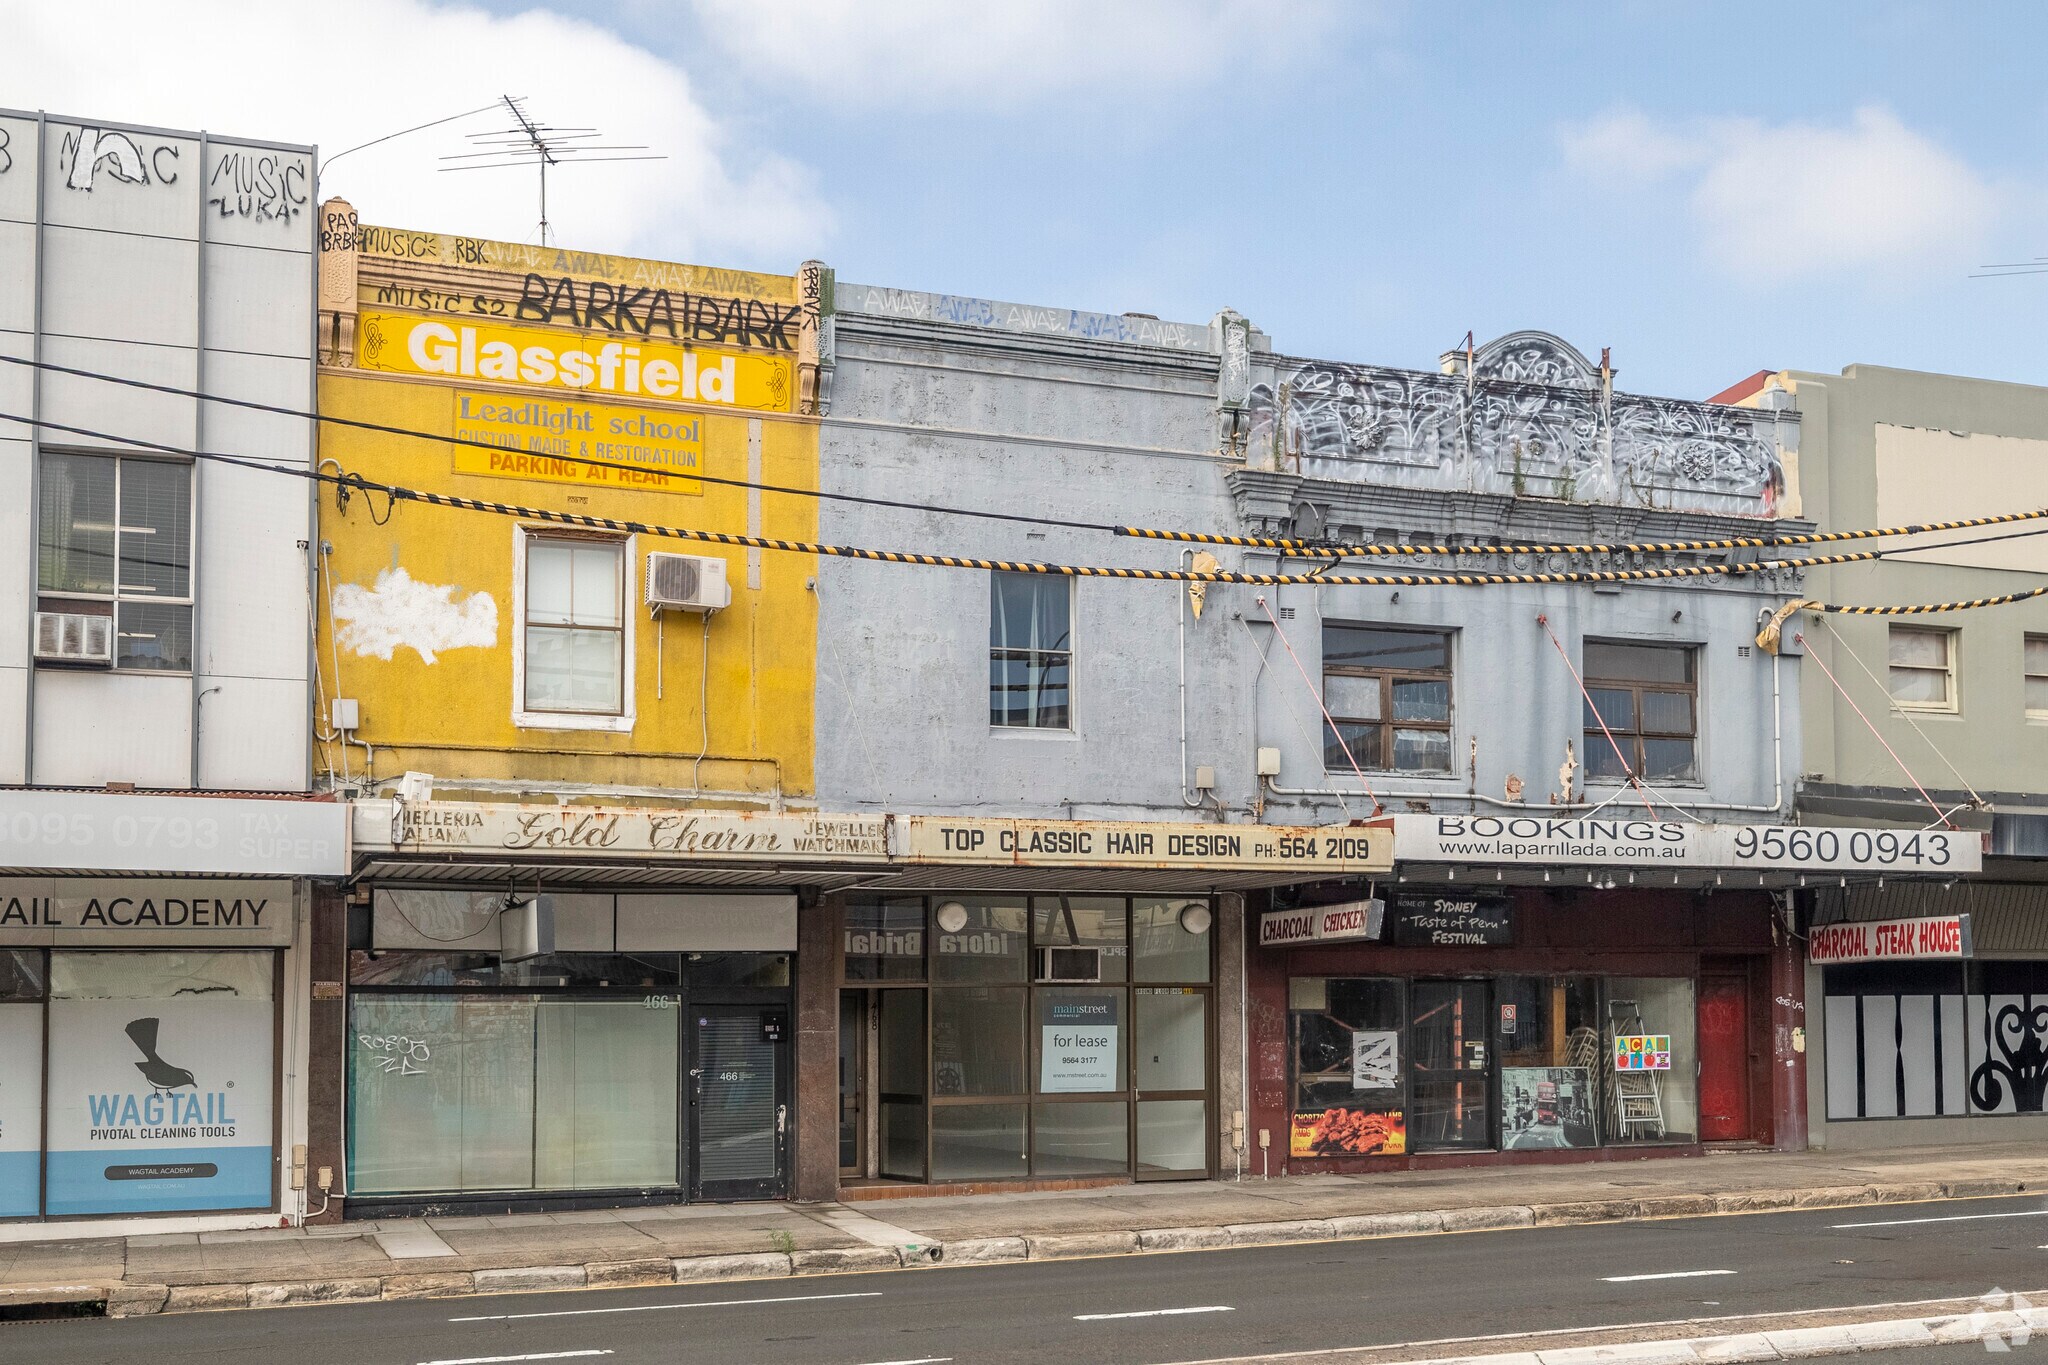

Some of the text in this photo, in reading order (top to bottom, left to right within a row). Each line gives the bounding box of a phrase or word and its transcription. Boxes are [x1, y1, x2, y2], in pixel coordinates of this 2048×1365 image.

[407, 321, 736, 404] Glassfield
[460, 396, 700, 443] Leadlight school
[458, 429, 697, 468] CUSTOM MADE & RESTORATION
[490, 452, 577, 477] PARKING
[619, 467, 670, 486] REAR
[0, 810, 219, 849] 095 0793
[240, 812, 289, 834] TAX
[503, 811, 781, 851] Gold Charm
[1438, 817, 1685, 842] BOOKINGS
[239, 837, 329, 860] SUPER
[941, 828, 1369, 860] TOP CLASSIC HAIR DESIGN PH: 564 2109
[1735, 827, 1951, 865] 9560 0943
[0, 897, 268, 926] AIL ACADEMY
[1434, 900, 1477, 913] SYDNEY
[1263, 908, 1367, 941] CHARCOAL CHICKEN
[1450, 916, 1465, 929] of
[1432, 930, 1487, 945] FESTIVAL
[1811, 921, 1960, 961] CHARCOAL STEAK HOUSE
[642, 995, 669, 1009] 466
[1053, 1004, 1108, 1014] mainstreet
[1053, 1034, 1108, 1047] for lease
[720, 1071, 739, 1081] 466
[88, 1092, 236, 1127] WAGTAIL
[90, 1126, 236, 1140] PIVOTAL CLEANING TOOLS
